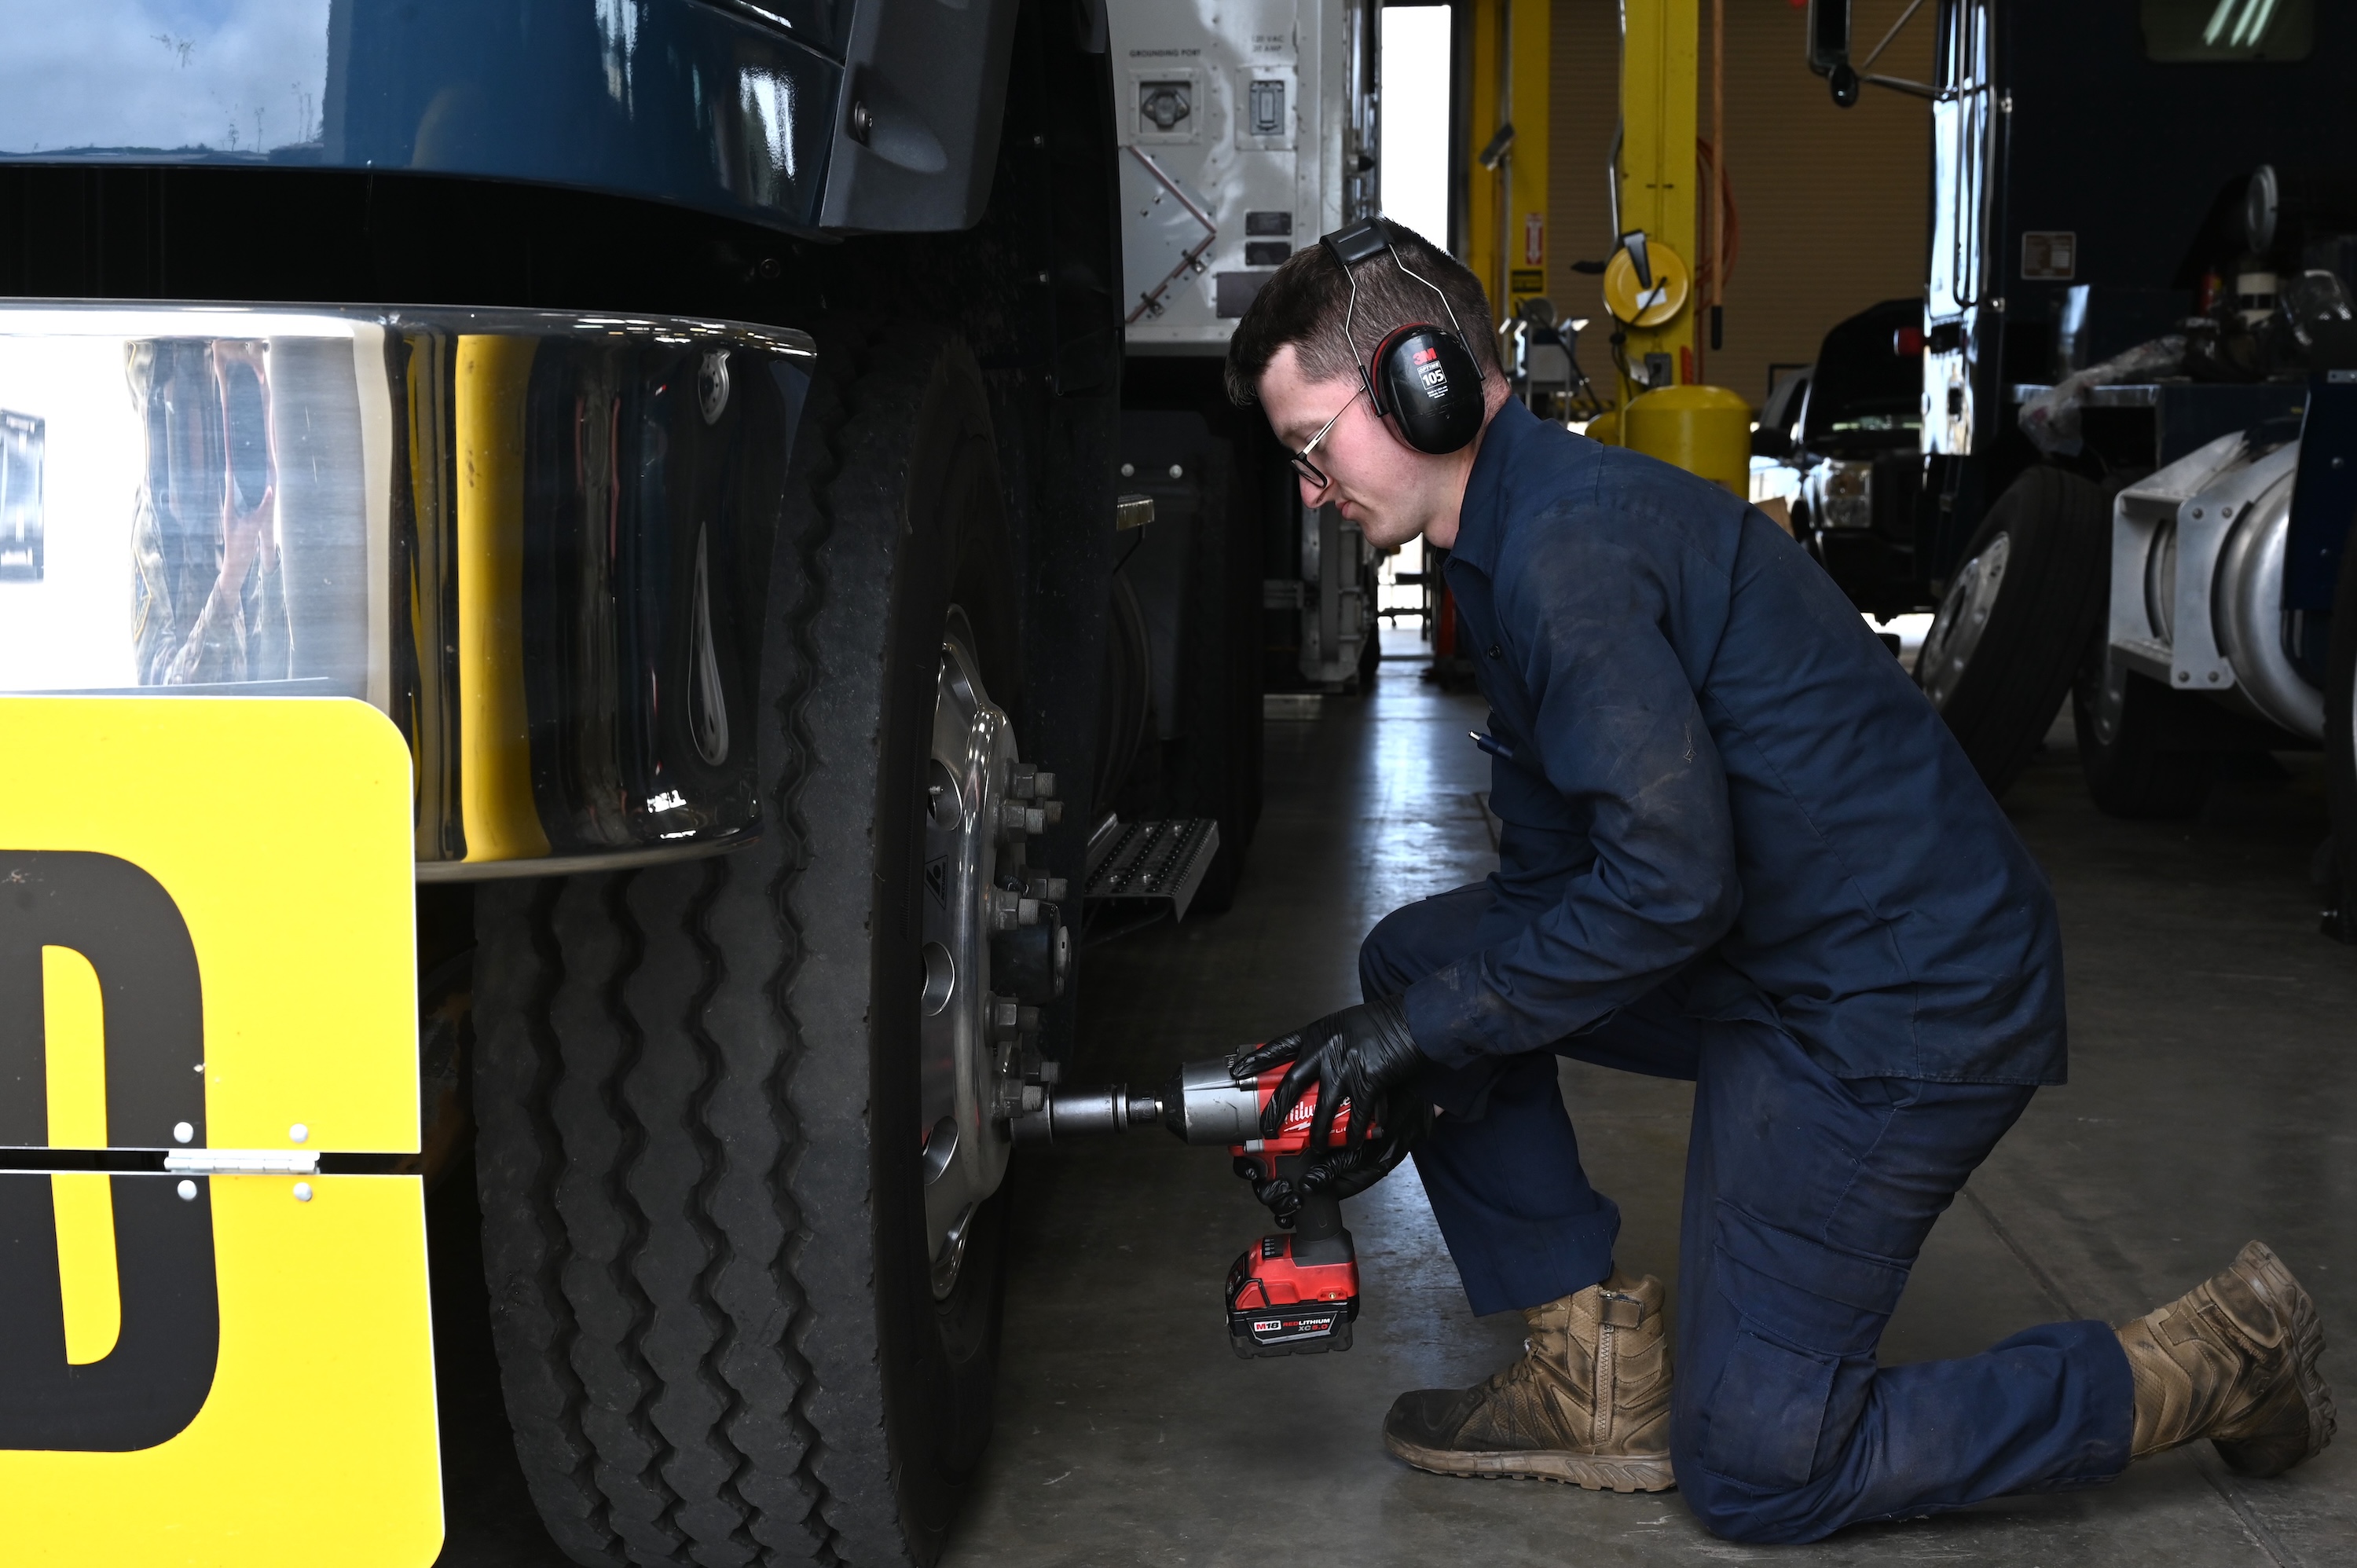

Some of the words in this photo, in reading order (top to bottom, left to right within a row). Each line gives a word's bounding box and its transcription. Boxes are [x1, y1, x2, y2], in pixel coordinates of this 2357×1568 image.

[1129, 49, 1178, 58] GROUNDING
[1181, 48, 1201, 57] PORT
[1413, 347, 1438, 365] 3M
[1422, 368, 1444, 387] 105
[1282, 1318, 1330, 1327] REDLITHIUM
